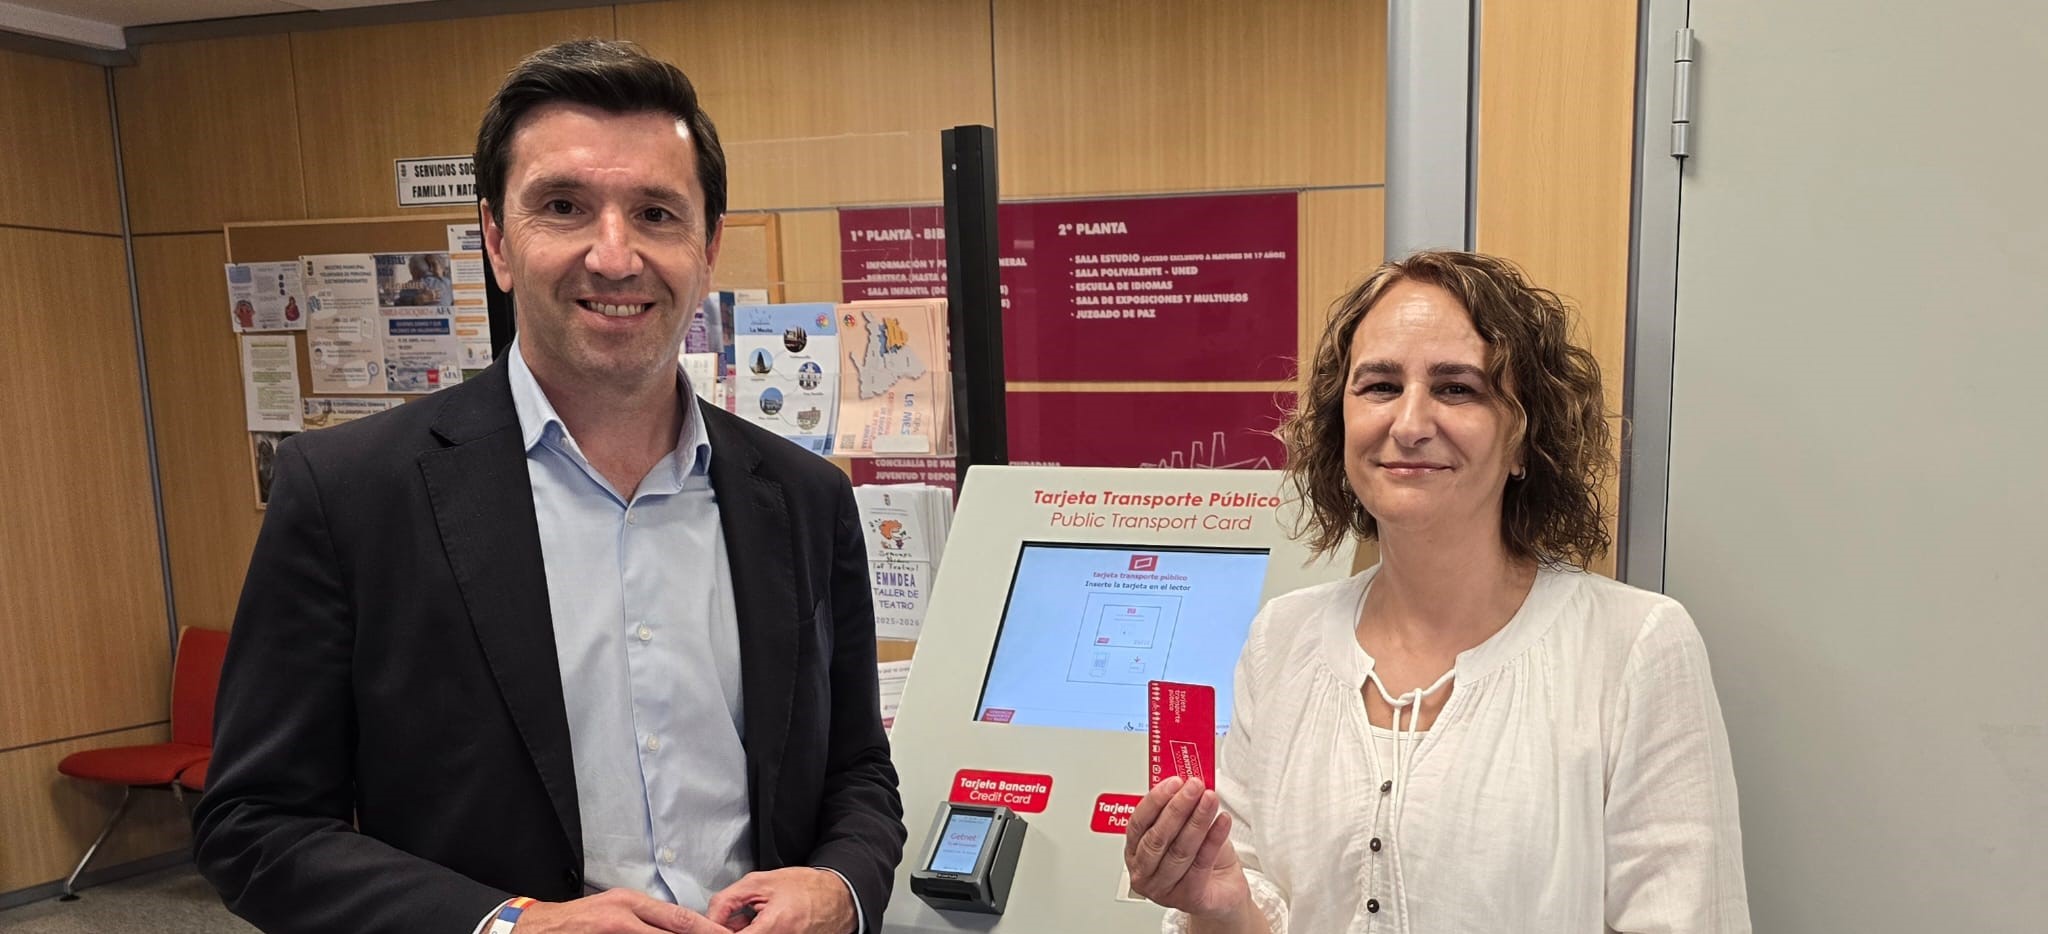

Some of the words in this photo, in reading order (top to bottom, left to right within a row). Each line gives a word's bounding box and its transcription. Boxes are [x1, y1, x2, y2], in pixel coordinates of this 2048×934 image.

[414, 163, 456, 177] SERVICIOS
[412, 184, 446, 198] FAMILIA
[448, 184, 454, 197] Y
[866, 228, 913, 241] PLANTA
[1076, 221, 1128, 235] PLANTA
[1075, 254, 1099, 264] SALA
[1100, 253, 1140, 263] ESTUDIO
[1075, 268, 1099, 278] SALA
[1100, 266, 1162, 277] POLIVALENTE
[1171, 265, 1198, 276] UNED
[1075, 282, 1115, 292] ESCUELA
[1116, 281, 1129, 290] DE
[1131, 280, 1173, 290] IDIOMAS
[1076, 295, 1100, 305] SALA
[1101, 295, 1114, 304] DE
[1115, 294, 1183, 305] EXPOSICIONES
[1184, 294, 1192, 303] Y
[1193, 292, 1249, 303] MULTIUSOS
[1076, 309, 1120, 319] JUZGADO
[1122, 308, 1135, 318] DE
[1137, 308, 1156, 318] PAZ
[876, 472, 918, 480] JUVENTUD
[919, 472, 926, 480] Y
[1034, 490, 1096, 508] Tarjeta
[1103, 491, 1203, 509] Transporte
[1209, 491, 1281, 508] Público
[1050, 512, 1105, 528] Public
[1112, 513, 1198, 532] Transport
[1203, 514, 1252, 530] Card
[876, 571, 916, 588] EMMDEA
[1093, 571, 1118, 580] tarjeta
[1119, 572, 1159, 581] transporte
[1160, 573, 1188, 581] público
[1085, 580, 1112, 588] Inserte
[1122, 582, 1147, 591] tarjeta
[1169, 583, 1192, 591] lector
[873, 587, 905, 598] TALLER
[908, 590, 919, 598] DE
[879, 600, 914, 610] TEATRO
[961, 778, 996, 790] Tarjeta
[999, 781, 1047, 794] Bancaria
[969, 790, 1002, 802] Credit
[1003, 793, 1032, 805] Card
[1099, 802, 1135, 815] Tarjeta
[1108, 816, 1129, 827] Pub
